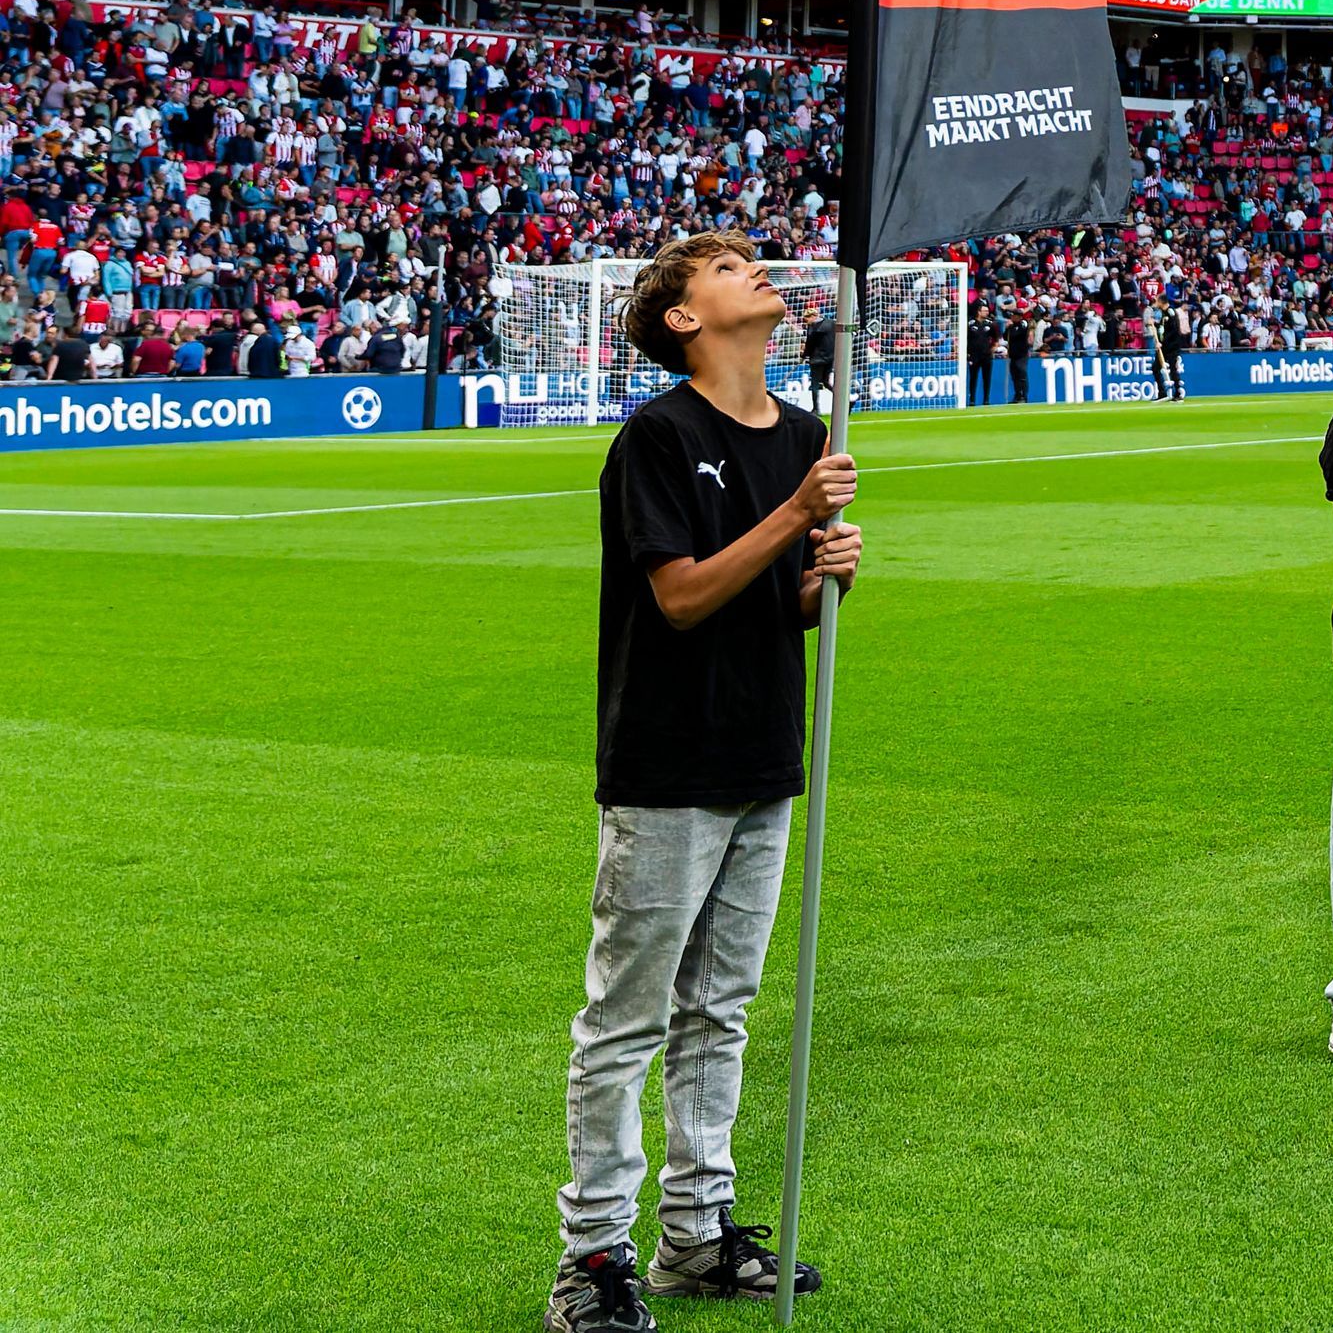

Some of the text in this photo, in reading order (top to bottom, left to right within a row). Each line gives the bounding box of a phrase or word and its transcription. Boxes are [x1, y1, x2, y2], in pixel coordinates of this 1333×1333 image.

[933, 86, 1074, 121] EENDRACHT
[926, 110, 1092, 148] MAAKT MACHT
[559, 370, 654, 395] HOTLS
[0, 392, 272, 437] nh-hotels.com
[538, 401, 623, 424] goodhbitz
